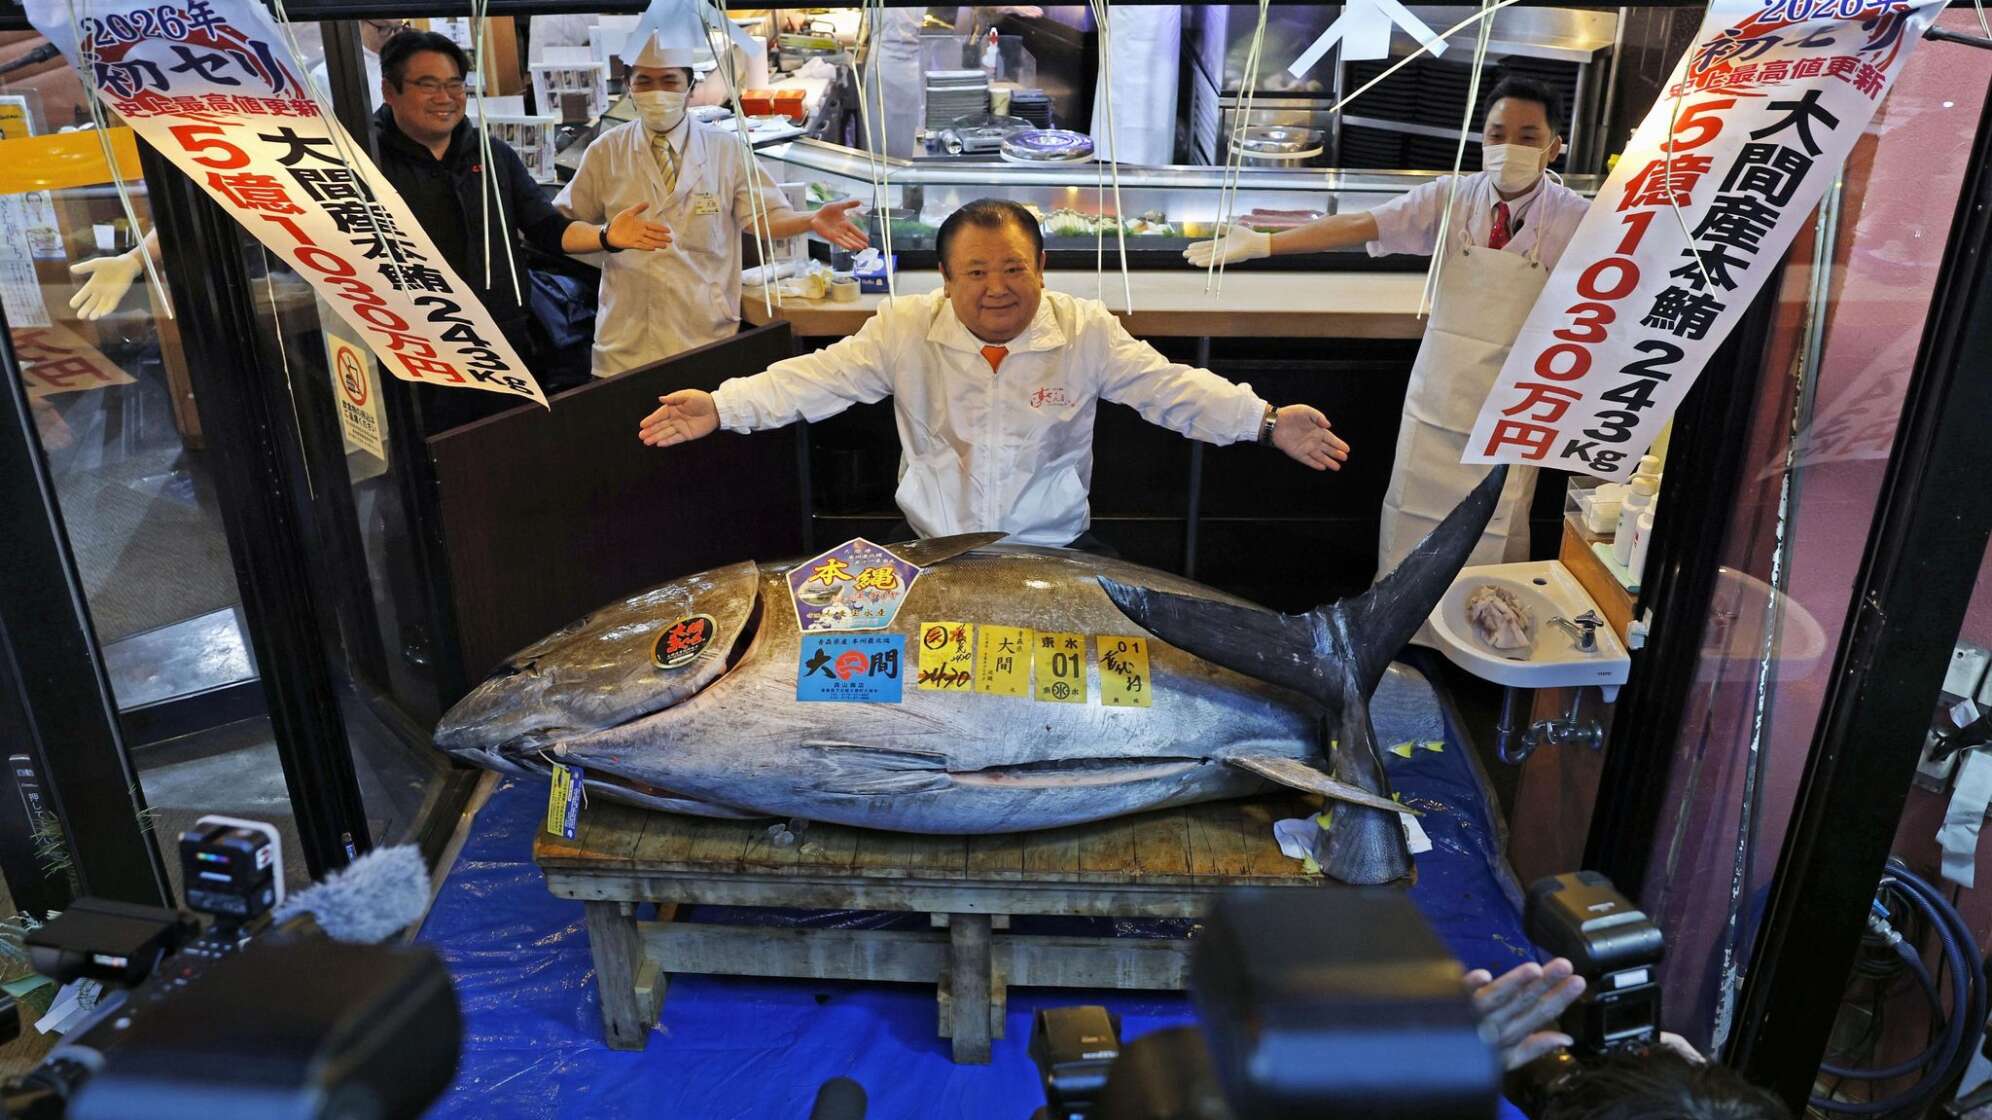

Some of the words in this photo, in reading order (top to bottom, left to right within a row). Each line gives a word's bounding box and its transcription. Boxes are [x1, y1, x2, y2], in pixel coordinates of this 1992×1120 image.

[81, 0, 227, 46] 2026年
[1694, 8, 1919, 72] 初セリ
[79, 40, 285, 98] 初セリ
[1666, 56, 1886, 100] 史上最高値更新
[114, 93, 320, 118] 史上最高値更新
[169, 125, 466, 384] 5億1030万円
[1483, 98, 1738, 460] 5億1030万円
[995, 637, 1016, 674] 大間
[1052, 652, 1080, 679] 01
[1117, 640, 1140, 654] 01
